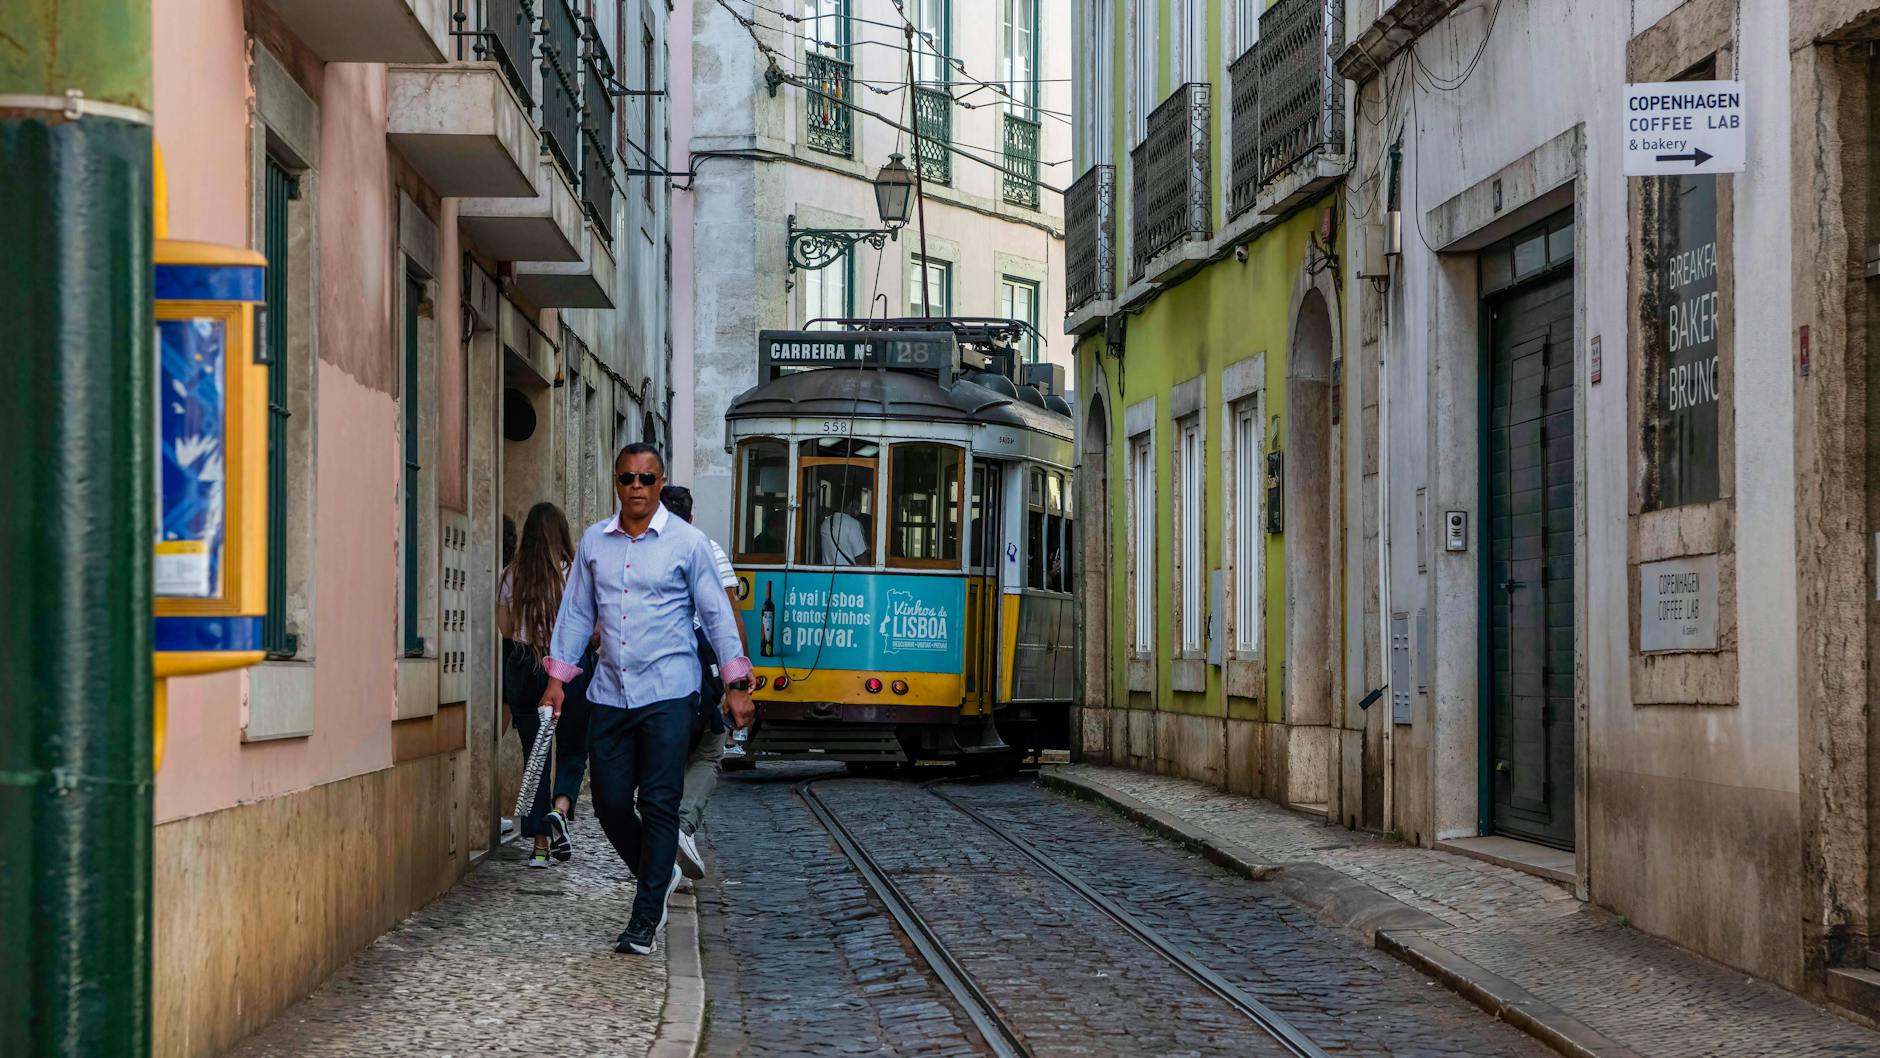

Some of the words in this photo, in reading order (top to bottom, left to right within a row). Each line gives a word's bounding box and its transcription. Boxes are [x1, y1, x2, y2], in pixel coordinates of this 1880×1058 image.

[1629, 93, 1739, 111] COPENHAGEN
[1629, 116, 1693, 132] COFFEE
[1707, 115, 1740, 129] LAB
[1629, 139, 1638, 151] &
[1642, 138, 1687, 151] bakery
[1669, 291, 1719, 353] BAKER
[770, 342, 846, 360] CARREIRA
[897, 341, 929, 363] 28
[823, 421, 847, 432] 558
[1659, 572, 1700, 595] COPENHAGEN
[799, 589, 818, 606] vai
[894, 599, 937, 616] Vinhos
[938, 605, 948, 616] de
[1658, 599, 1683, 621] COFFEE
[1686, 598, 1699, 619] LAB
[783, 609, 790, 622] e
[792, 609, 827, 624] tantos
[831, 609, 872, 625] vinhos
[893, 616, 948, 639] LISBOA
[782, 626, 792, 645] a
[796, 627, 858, 652] provar.
